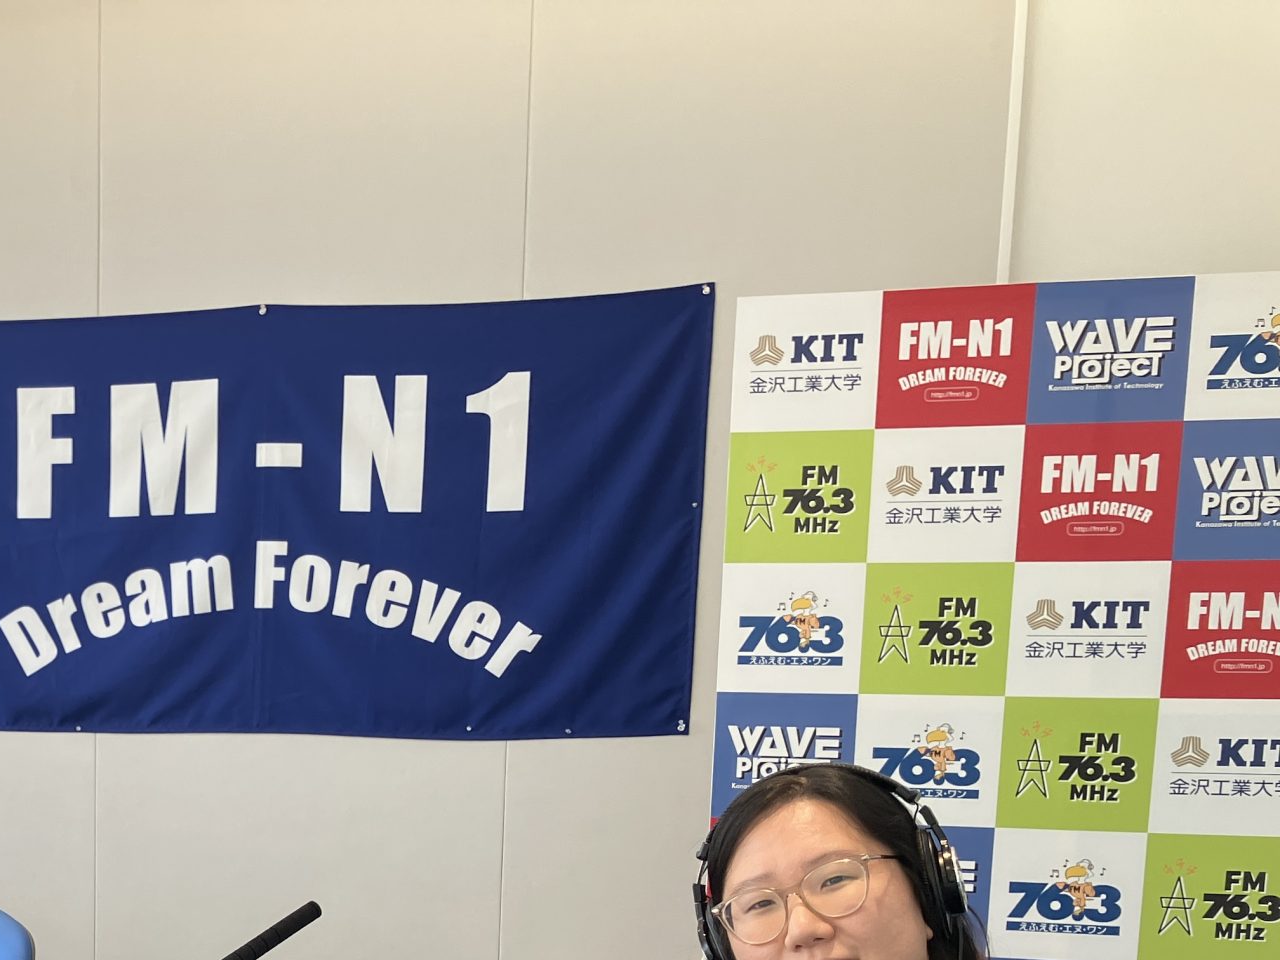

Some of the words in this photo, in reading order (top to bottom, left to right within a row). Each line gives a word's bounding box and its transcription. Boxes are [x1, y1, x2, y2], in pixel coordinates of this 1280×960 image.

[790, 333, 863, 363] KIT
[899, 318, 1013, 360] FM-N1
[1046, 317, 1174, 353] WAVE
[1208, 334, 1280, 375] 76
[749, 374, 862, 394] 金沢工業大学
[899, 367, 945, 391] DREAM
[949, 366, 1007, 388] FOREVER
[1221, 379, 1279, 388] えふえむ・エ
[16, 370, 531, 519] FM-N1
[802, 465, 838, 486] FM
[929, 466, 1005, 494] KIT
[1040, 453, 1160, 493] FM-N1
[1193, 456, 1280, 490] WAV
[782, 488, 854, 514] 76.3
[1040, 501, 1089, 524] DREAM
[1093, 501, 1153, 523] FOREVER
[1201, 491, 1280, 521] Proje
[794, 517, 838, 533] MHz
[885, 506, 1002, 524] 金沢工業大学
[253, 540, 543, 679] Forever
[938, 597, 977, 617] FM
[1070, 601, 1150, 629] KIT
[1187, 592, 1280, 629] FM-N
[919, 620, 993, 647] 76.3
[930, 649, 976, 665] MHz
[1025, 641, 1147, 658] 金沢工業大学
[1186, 639, 1237, 661] DREAM
[1240, 638, 1280, 656] FORE
[727, 725, 841, 758] WAVE
[1079, 733, 1119, 753] FM
[1058, 755, 1135, 783] 76.3
[1070, 784, 1119, 801] MHz
[1169, 778, 1280, 797] 金沢工業大
[1225, 871, 1267, 893] FM
[1202, 893, 1280, 921] 76.3
[1215, 922, 1265, 941] MHz
